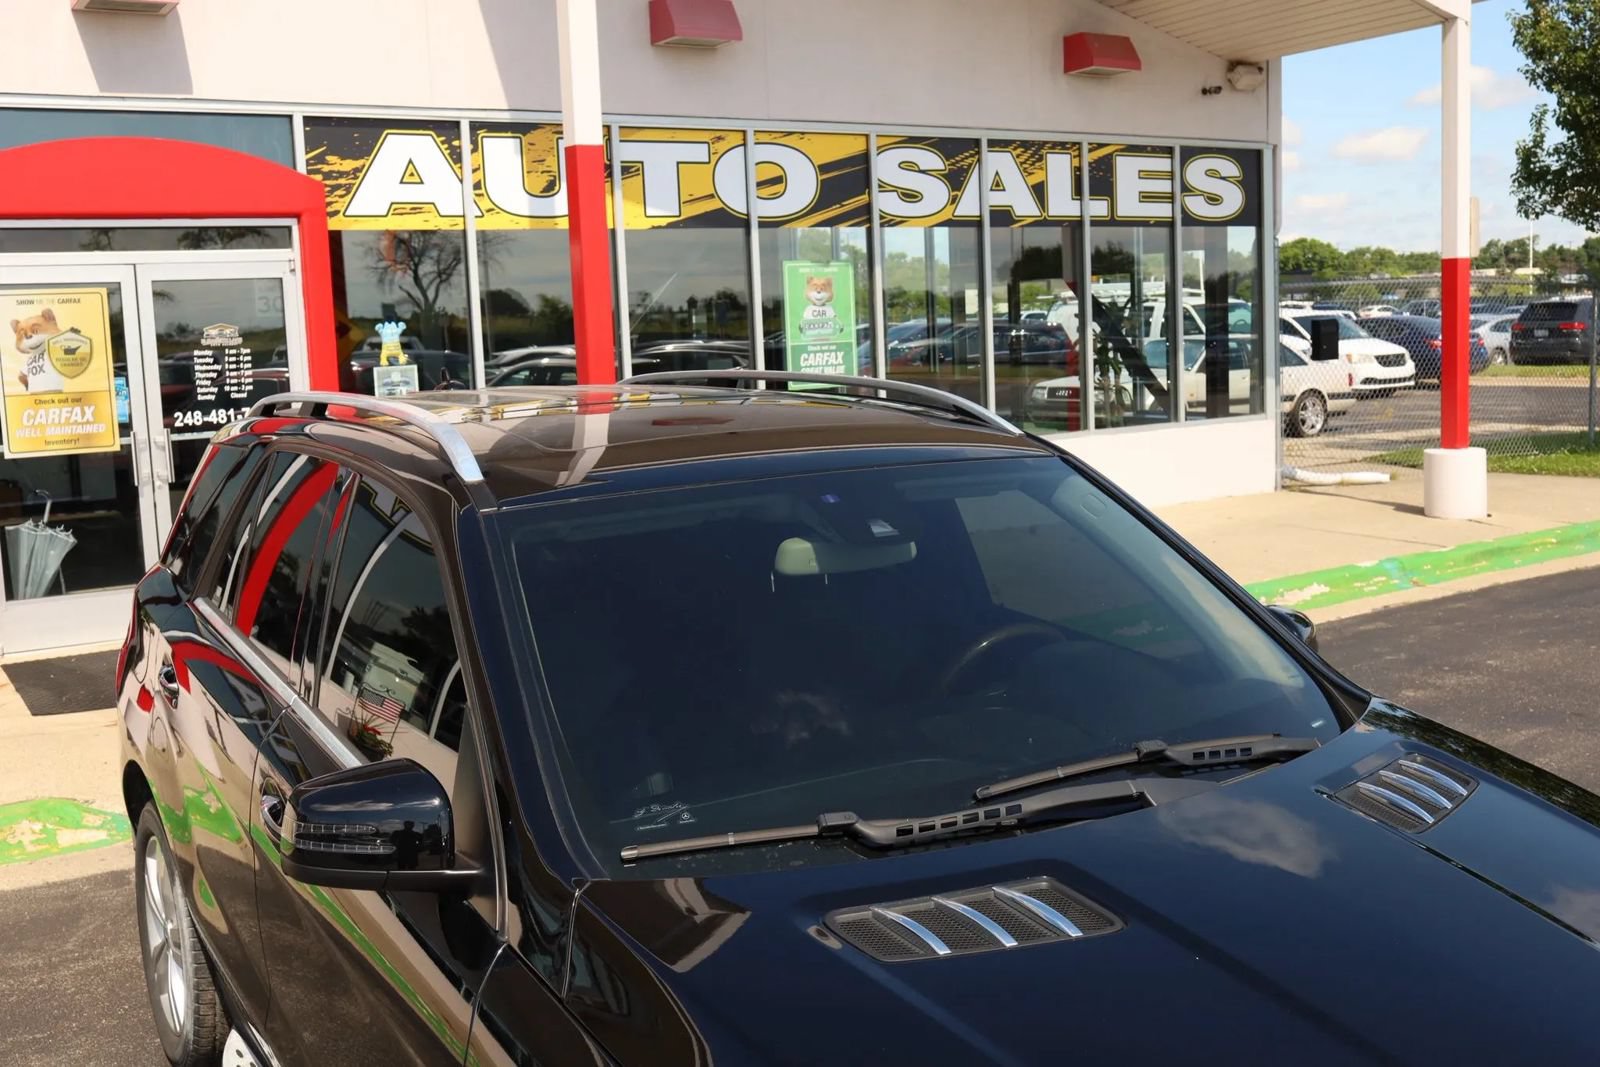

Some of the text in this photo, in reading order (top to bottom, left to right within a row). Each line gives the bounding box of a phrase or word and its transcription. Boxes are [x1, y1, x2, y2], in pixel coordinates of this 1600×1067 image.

[342, 130, 1245, 221] AUTO SALES
[27, 352, 45, 366] CAR
[800, 352, 844, 366] CARFAX
[28, 364, 46, 376] FOX
[22, 406, 96, 426] CARFAX
[16, 424, 106, 438] WELL MAINTAINED
